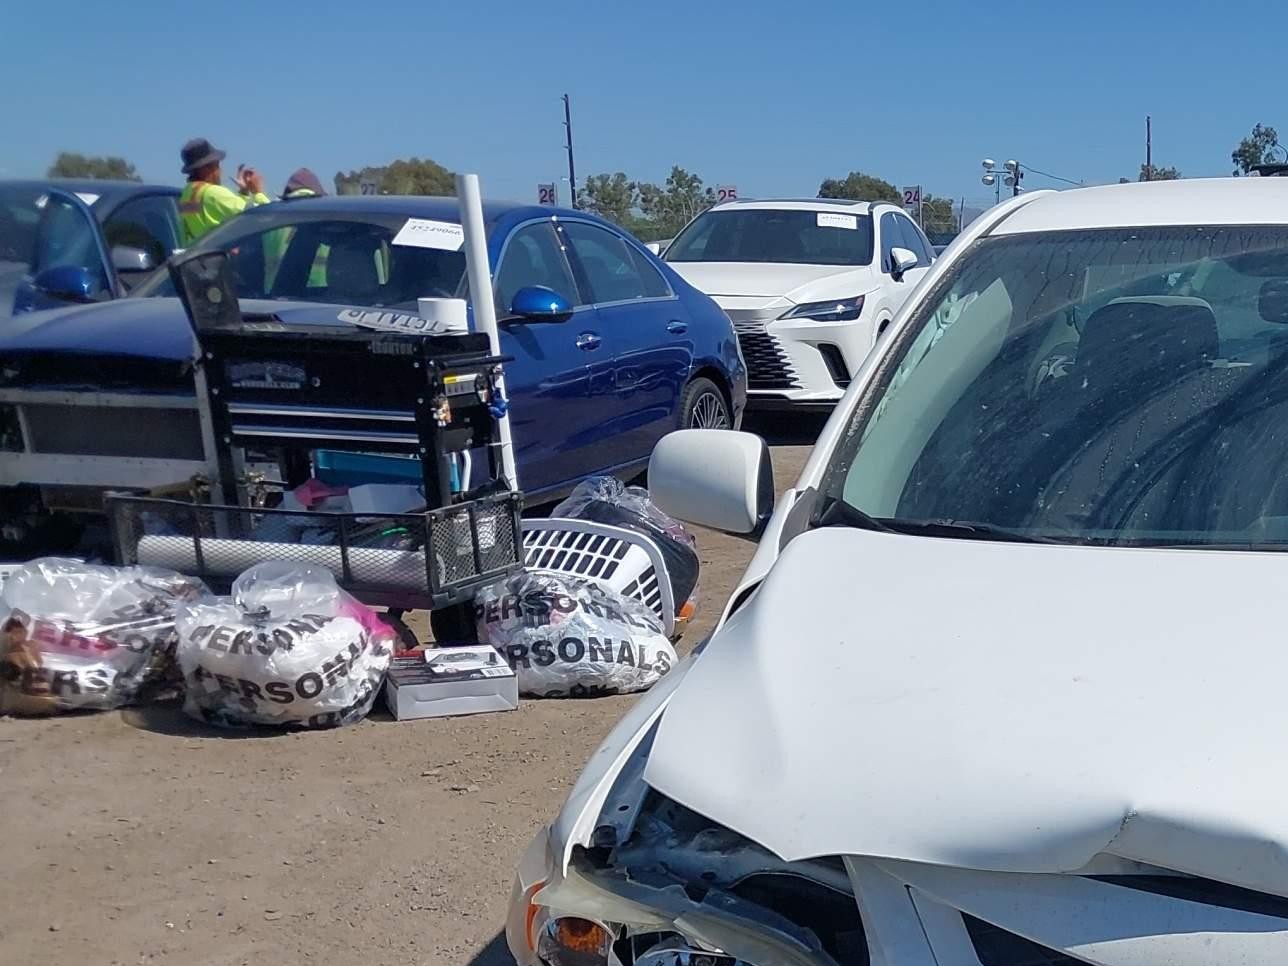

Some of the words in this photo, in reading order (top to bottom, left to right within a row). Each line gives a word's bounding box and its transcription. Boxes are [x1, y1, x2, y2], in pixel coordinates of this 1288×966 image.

[718, 189, 737, 200] 25
[905, 191, 919, 204] 24
[497, 636, 671, 676] RSONALS
